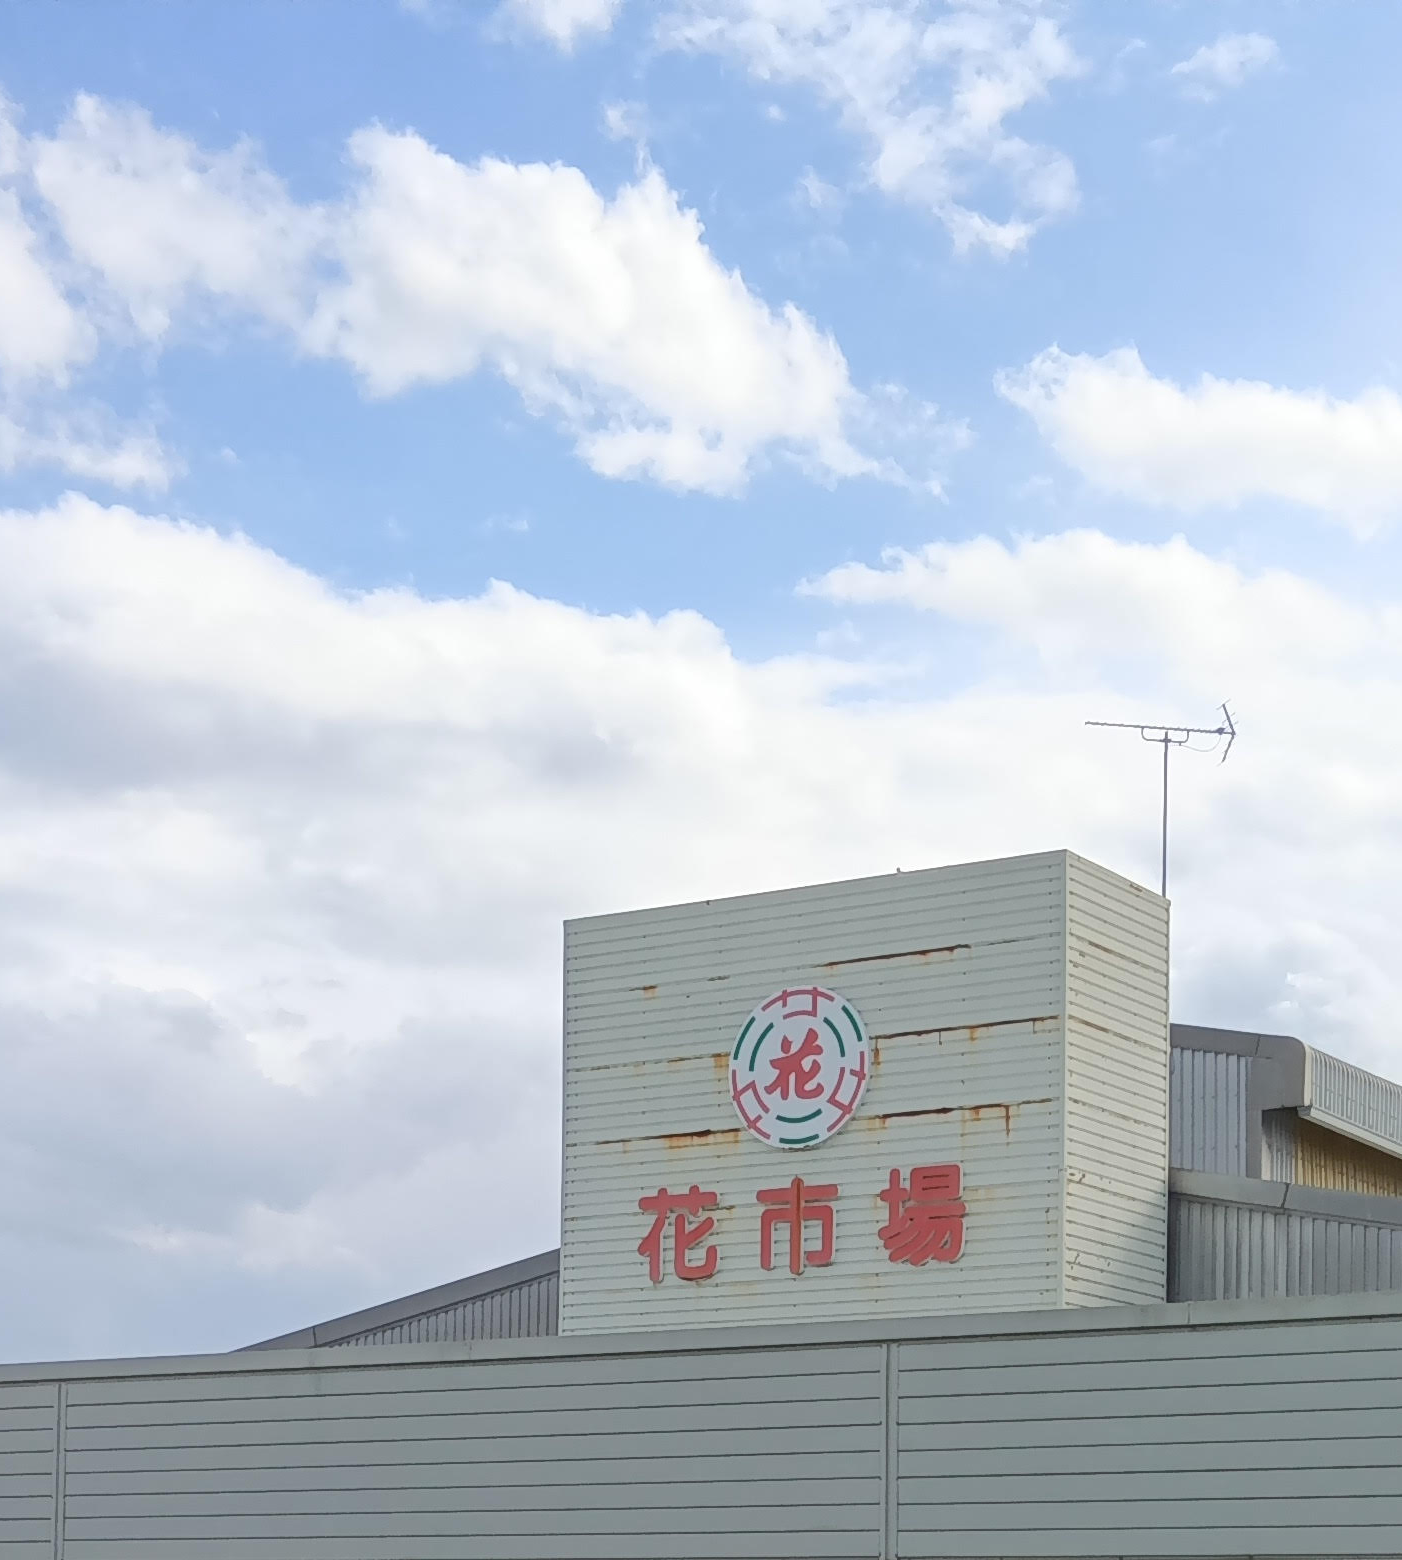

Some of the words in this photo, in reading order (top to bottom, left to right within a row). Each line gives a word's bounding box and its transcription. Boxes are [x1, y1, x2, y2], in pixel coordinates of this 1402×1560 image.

[764, 1028, 824, 1100] 花
[637, 1163, 968, 1285] 花市場
